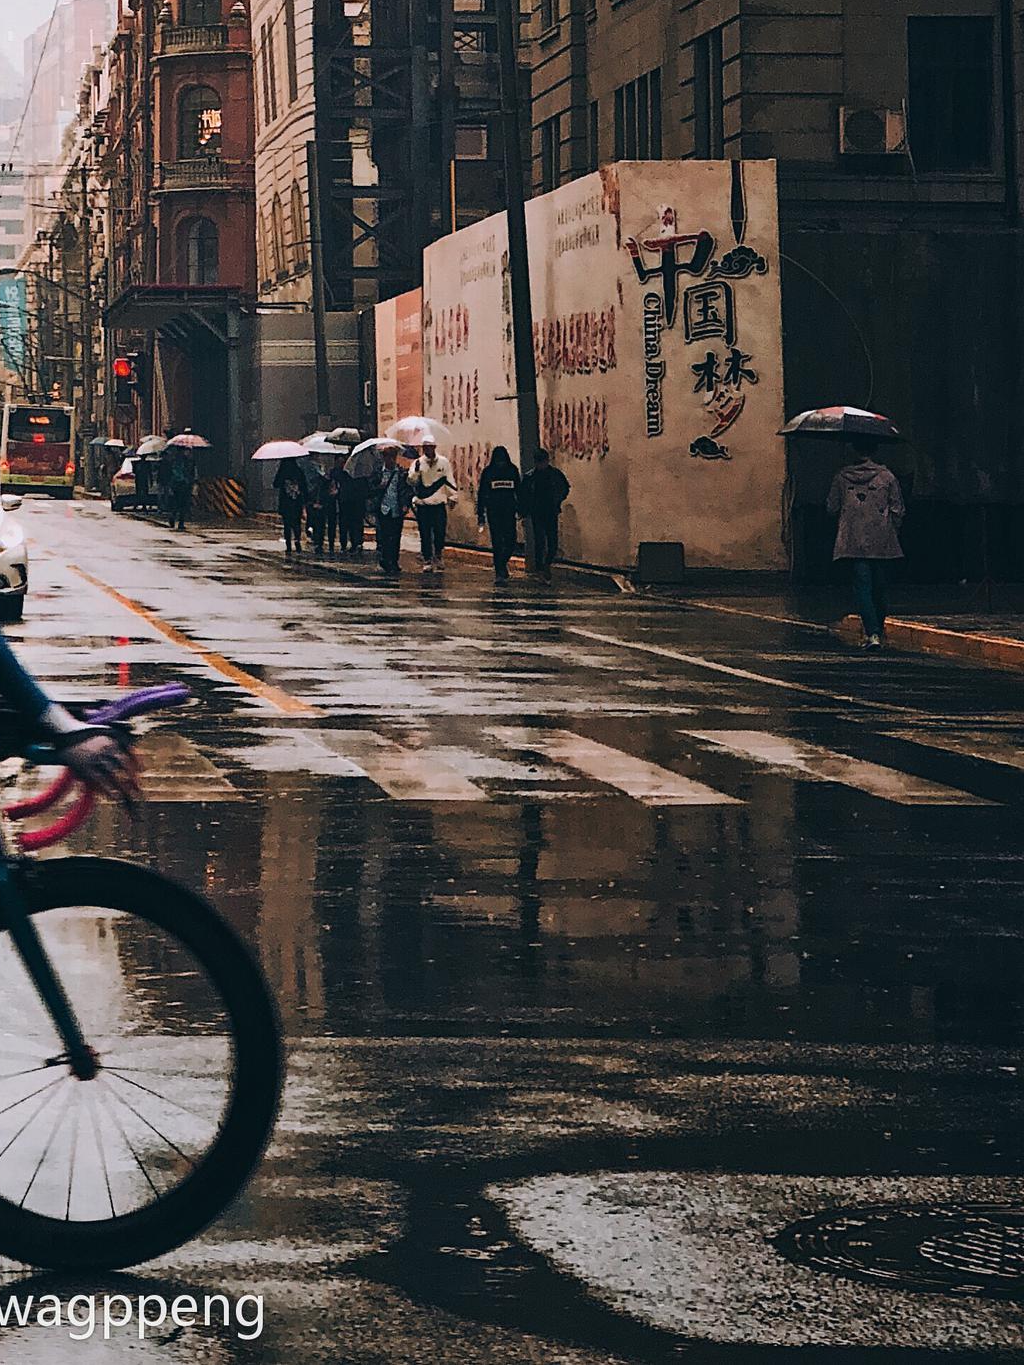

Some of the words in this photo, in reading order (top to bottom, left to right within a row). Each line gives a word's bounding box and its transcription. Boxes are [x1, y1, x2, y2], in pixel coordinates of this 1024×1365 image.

[625, 204, 758, 438] 中国梦
[643, 292, 663, 359] China
[645, 360, 665, 437] Dream
